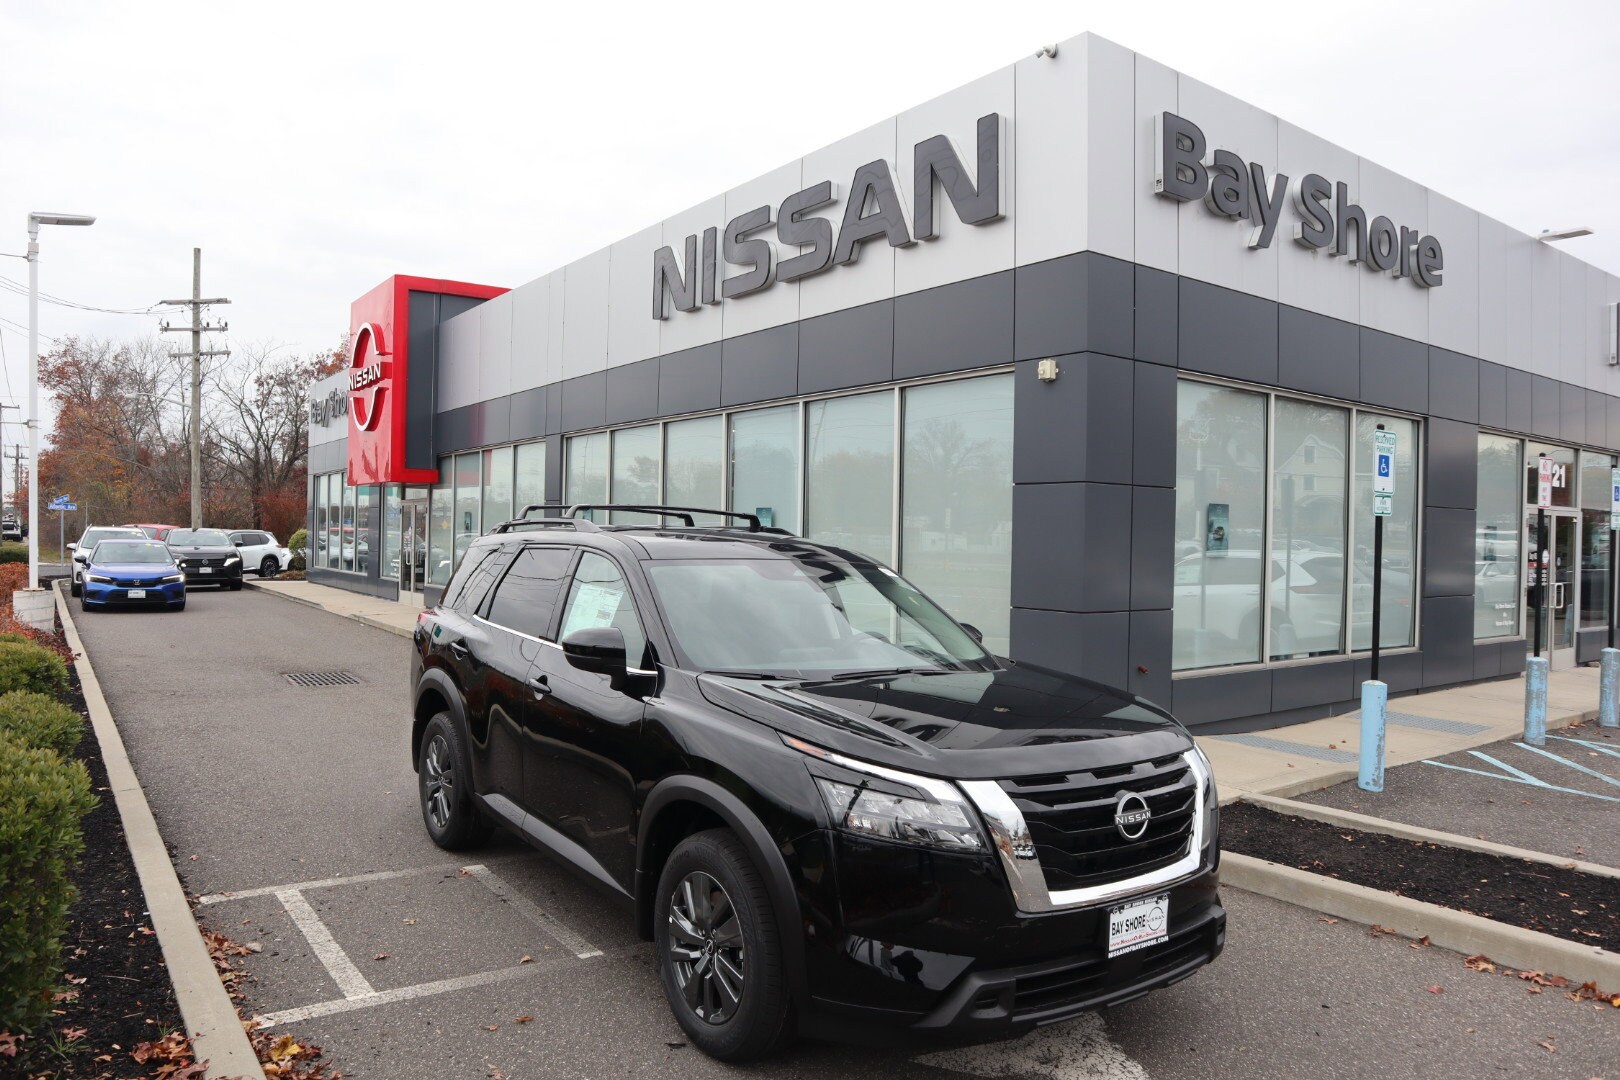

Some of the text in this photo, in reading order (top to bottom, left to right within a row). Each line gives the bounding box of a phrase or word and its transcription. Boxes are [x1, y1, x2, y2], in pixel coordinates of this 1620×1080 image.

[652, 112, 1005, 321] NISSAN
[1154, 111, 1444, 288] Bay Shore
[349, 361, 382, 392] NISSAN
[311, 388, 349, 428] Bay Sho
[1115, 810, 1152, 826] NISSAN
[1111, 914, 1146, 937] BAY SHORE
